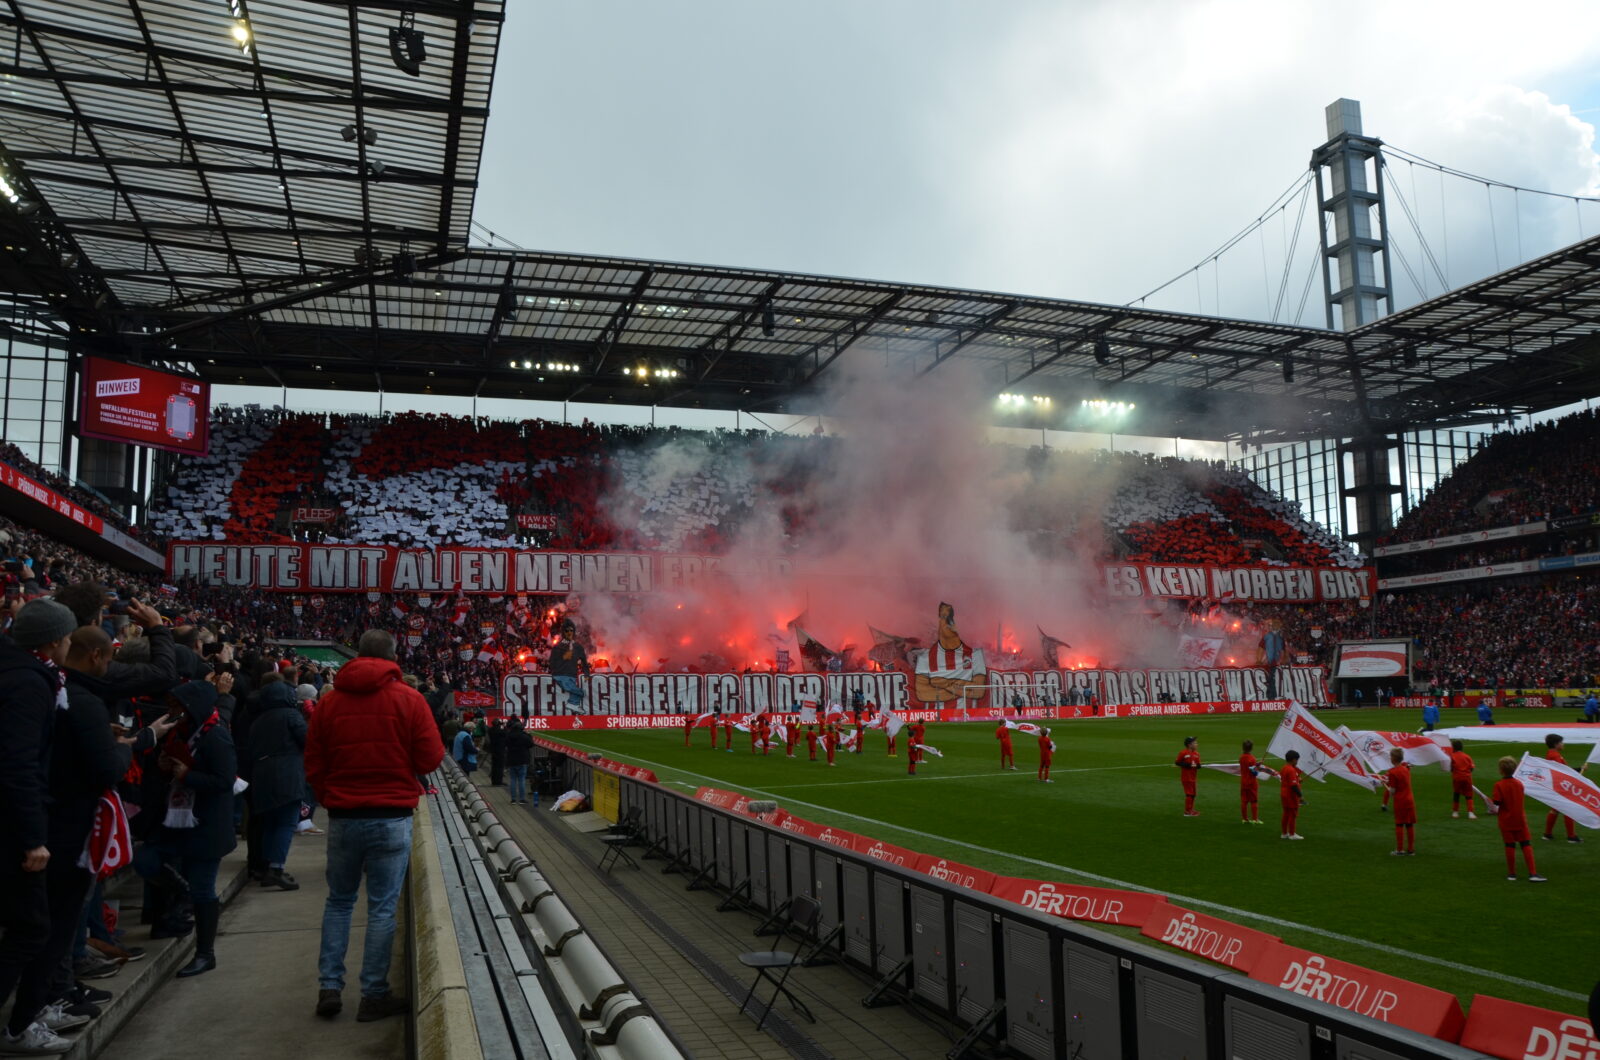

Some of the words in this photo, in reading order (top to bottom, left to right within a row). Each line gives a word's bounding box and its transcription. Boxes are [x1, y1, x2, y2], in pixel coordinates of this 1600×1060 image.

[98, 380, 138, 395] HINWEIS
[518, 515, 556, 527] HAWKS
[173, 545, 301, 590] HEUTE
[310, 547, 387, 590] MIT
[392, 551, 507, 591] ALLEN
[516, 552, 652, 593] MEINEN
[1105, 566, 1143, 597] ES
[1145, 566, 1207, 598] KEIN
[1211, 568, 1314, 600] MORGEN
[1319, 570, 1370, 601] GIBT
[580, 675, 626, 716] ICH
[634, 674, 701, 716] BEIM
[706, 675, 739, 714] FC
[743, 675, 772, 714] IN
[776, 674, 823, 713] DER
[828, 674, 907, 712] KURVE
[991, 671, 1031, 708] DER
[1066, 670, 1100, 706] IST
[1104, 669, 1146, 706] DAS
[1150, 670, 1221, 704] EINZIGE
[1225, 668, 1267, 702] WAS
[607, 715, 650, 728] SPÜRBAR
[1130, 704, 1162, 715] SPÜRBAR
[1163, 704, 1192, 714] ANDERS.
[1261, 701, 1288, 712] ANDERS.
[1021, 886, 1124, 922] DERTOUR
[1161, 915, 1243, 964] DERTOUR
[1279, 958, 1398, 1022] DERTOUR
